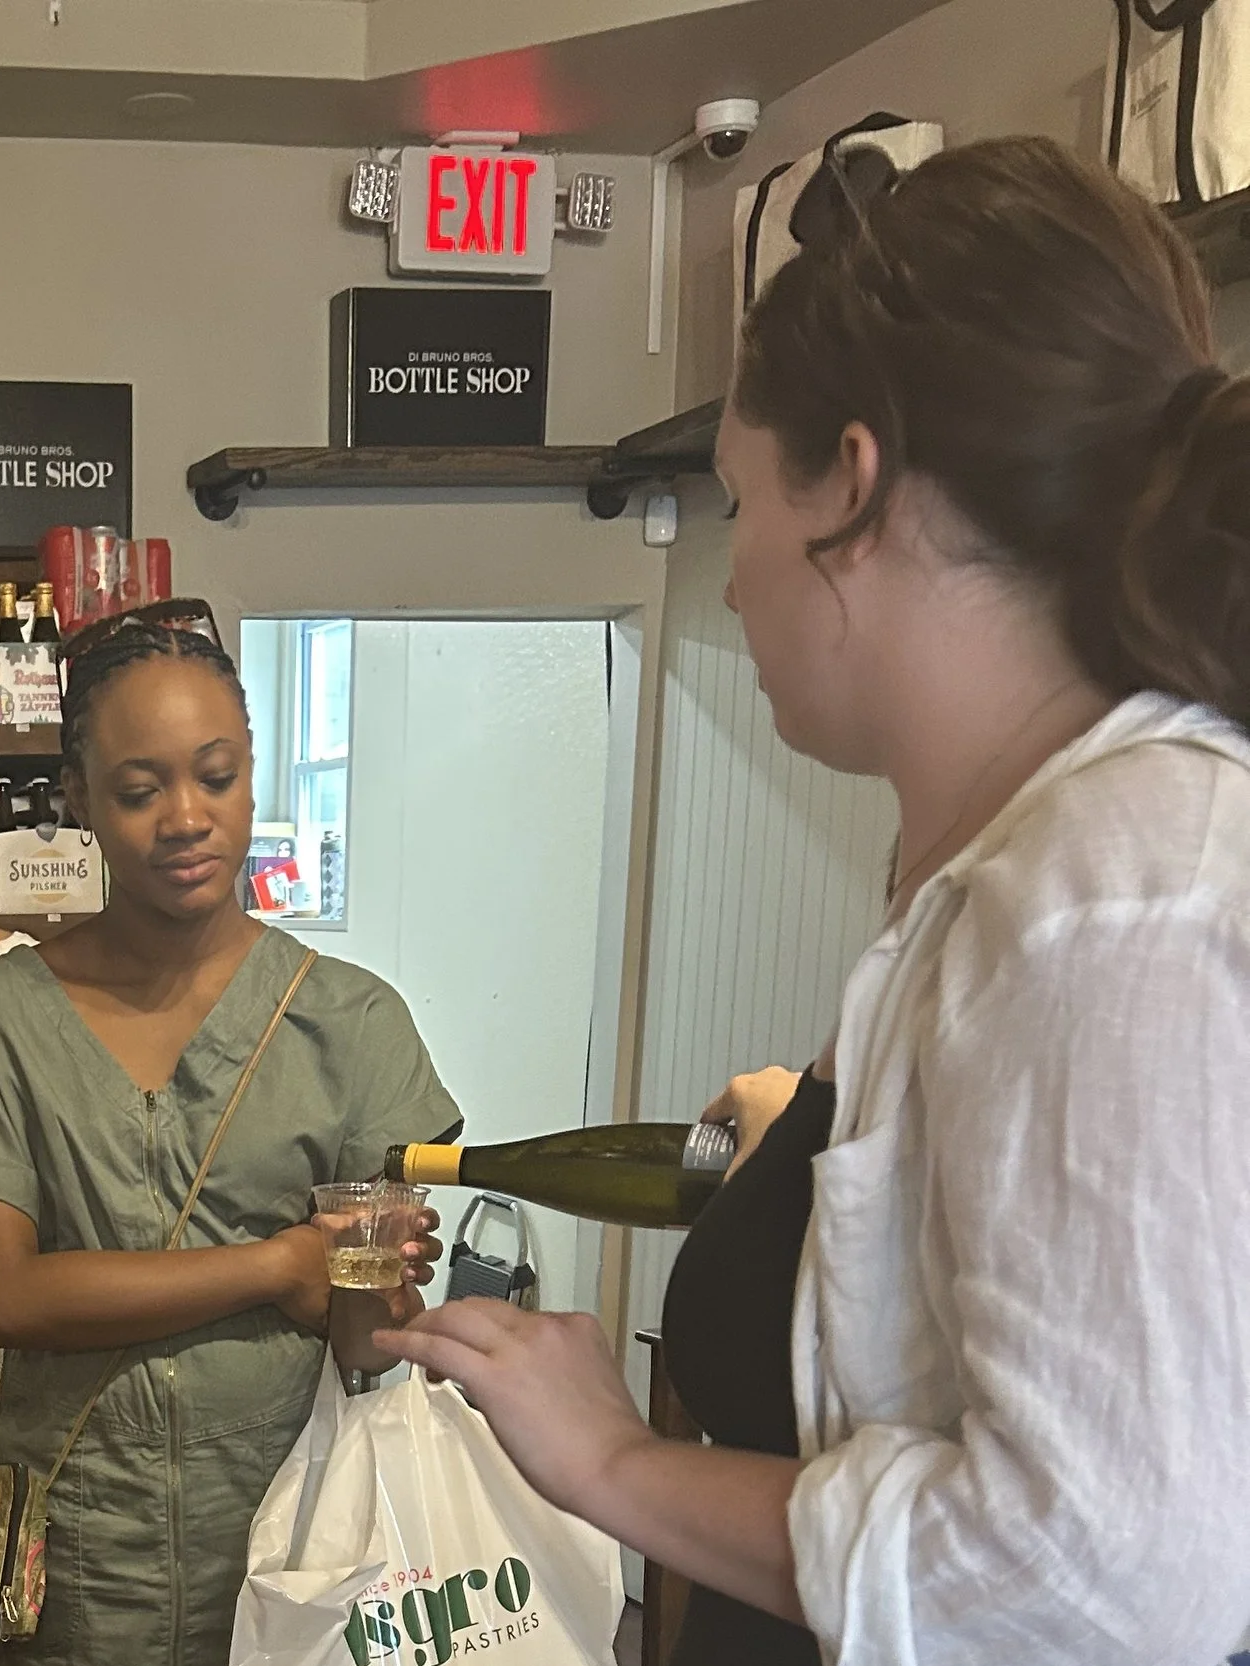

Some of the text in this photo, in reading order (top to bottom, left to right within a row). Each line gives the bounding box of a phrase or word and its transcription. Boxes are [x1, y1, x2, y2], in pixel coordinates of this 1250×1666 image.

[425, 154, 536, 255] EXIT
[408, 352, 495, 363] DI BRUNO BROS.
[368, 367, 530, 394] BOTTLE SHOP
[41, 446, 75, 457] BROS.
[45, 460, 114, 488] SHOP
[9, 858, 88, 881] SUNSHINE
[30, 882, 67, 891] PILSNER
[393, 1567, 433, 1587] 1904
[452, 1612, 539, 1658] PASTRIES
